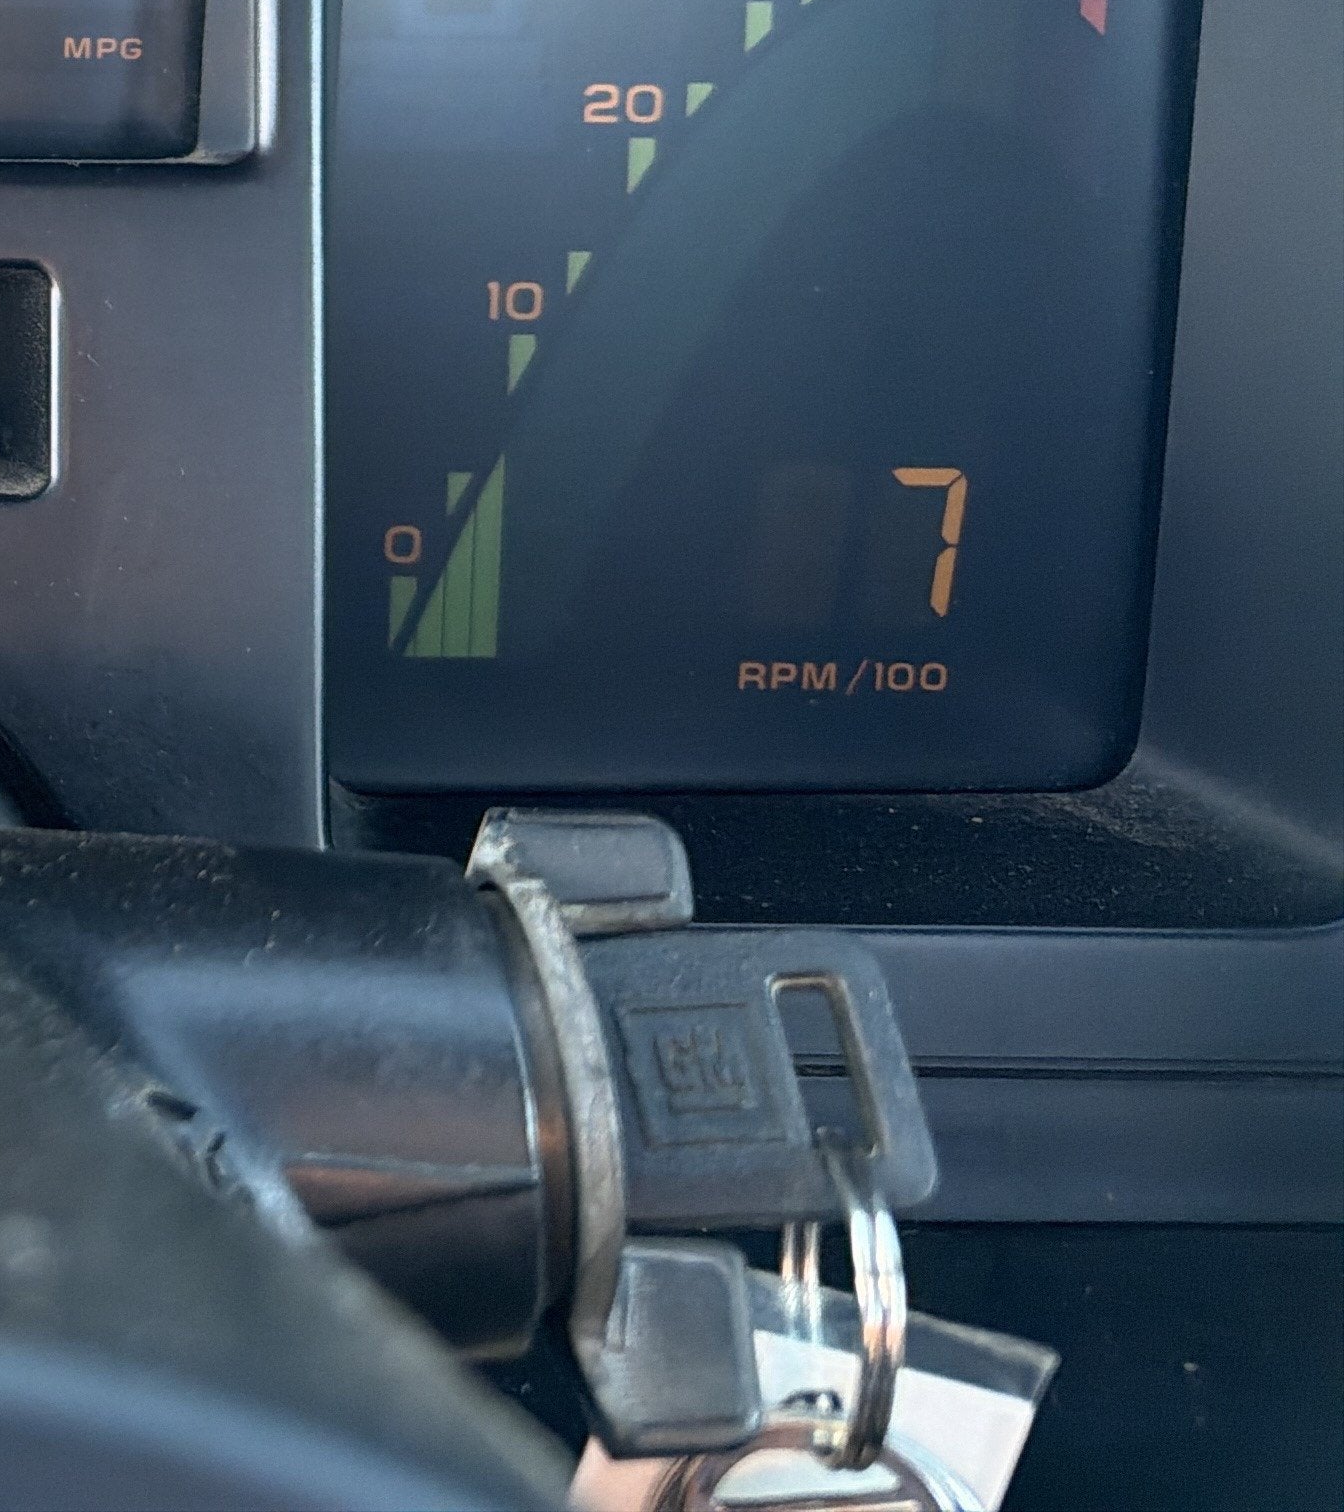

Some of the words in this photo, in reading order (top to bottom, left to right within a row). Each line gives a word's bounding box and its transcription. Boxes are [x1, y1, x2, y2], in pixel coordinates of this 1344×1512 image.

[64, 37, 142, 59] MPG
[584, 84, 663, 123] 20
[488, 281, 543, 320] 10
[384, 525, 422, 564] 0
[893, 468, 967, 616] 7
